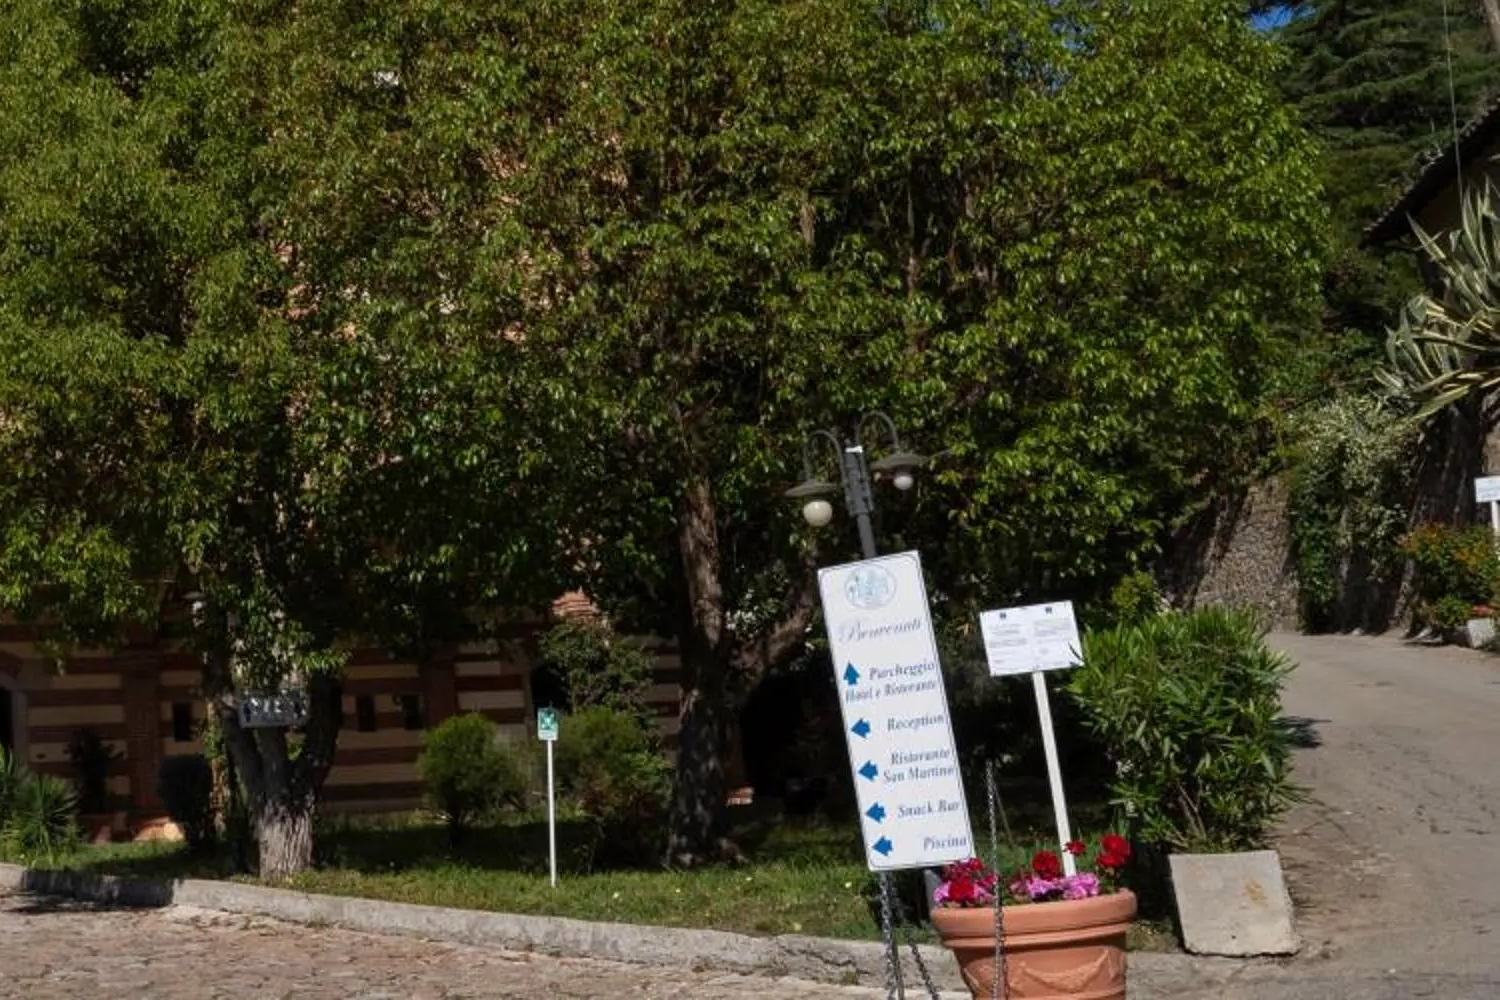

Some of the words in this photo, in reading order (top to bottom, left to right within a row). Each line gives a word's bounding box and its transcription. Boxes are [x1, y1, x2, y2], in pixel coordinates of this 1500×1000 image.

[869, 659, 935, 681] Parcheggio
[884, 681, 936, 696] Ristorante
[887, 714, 945, 732] Reception
[891, 749, 950, 764] Ristorante
[883, 769, 905, 783] San
[908, 766, 954, 780] Martino
[898, 800, 933, 818] Snack
[938, 799, 960, 813] Bar
[923, 834, 967, 851] Piscina
